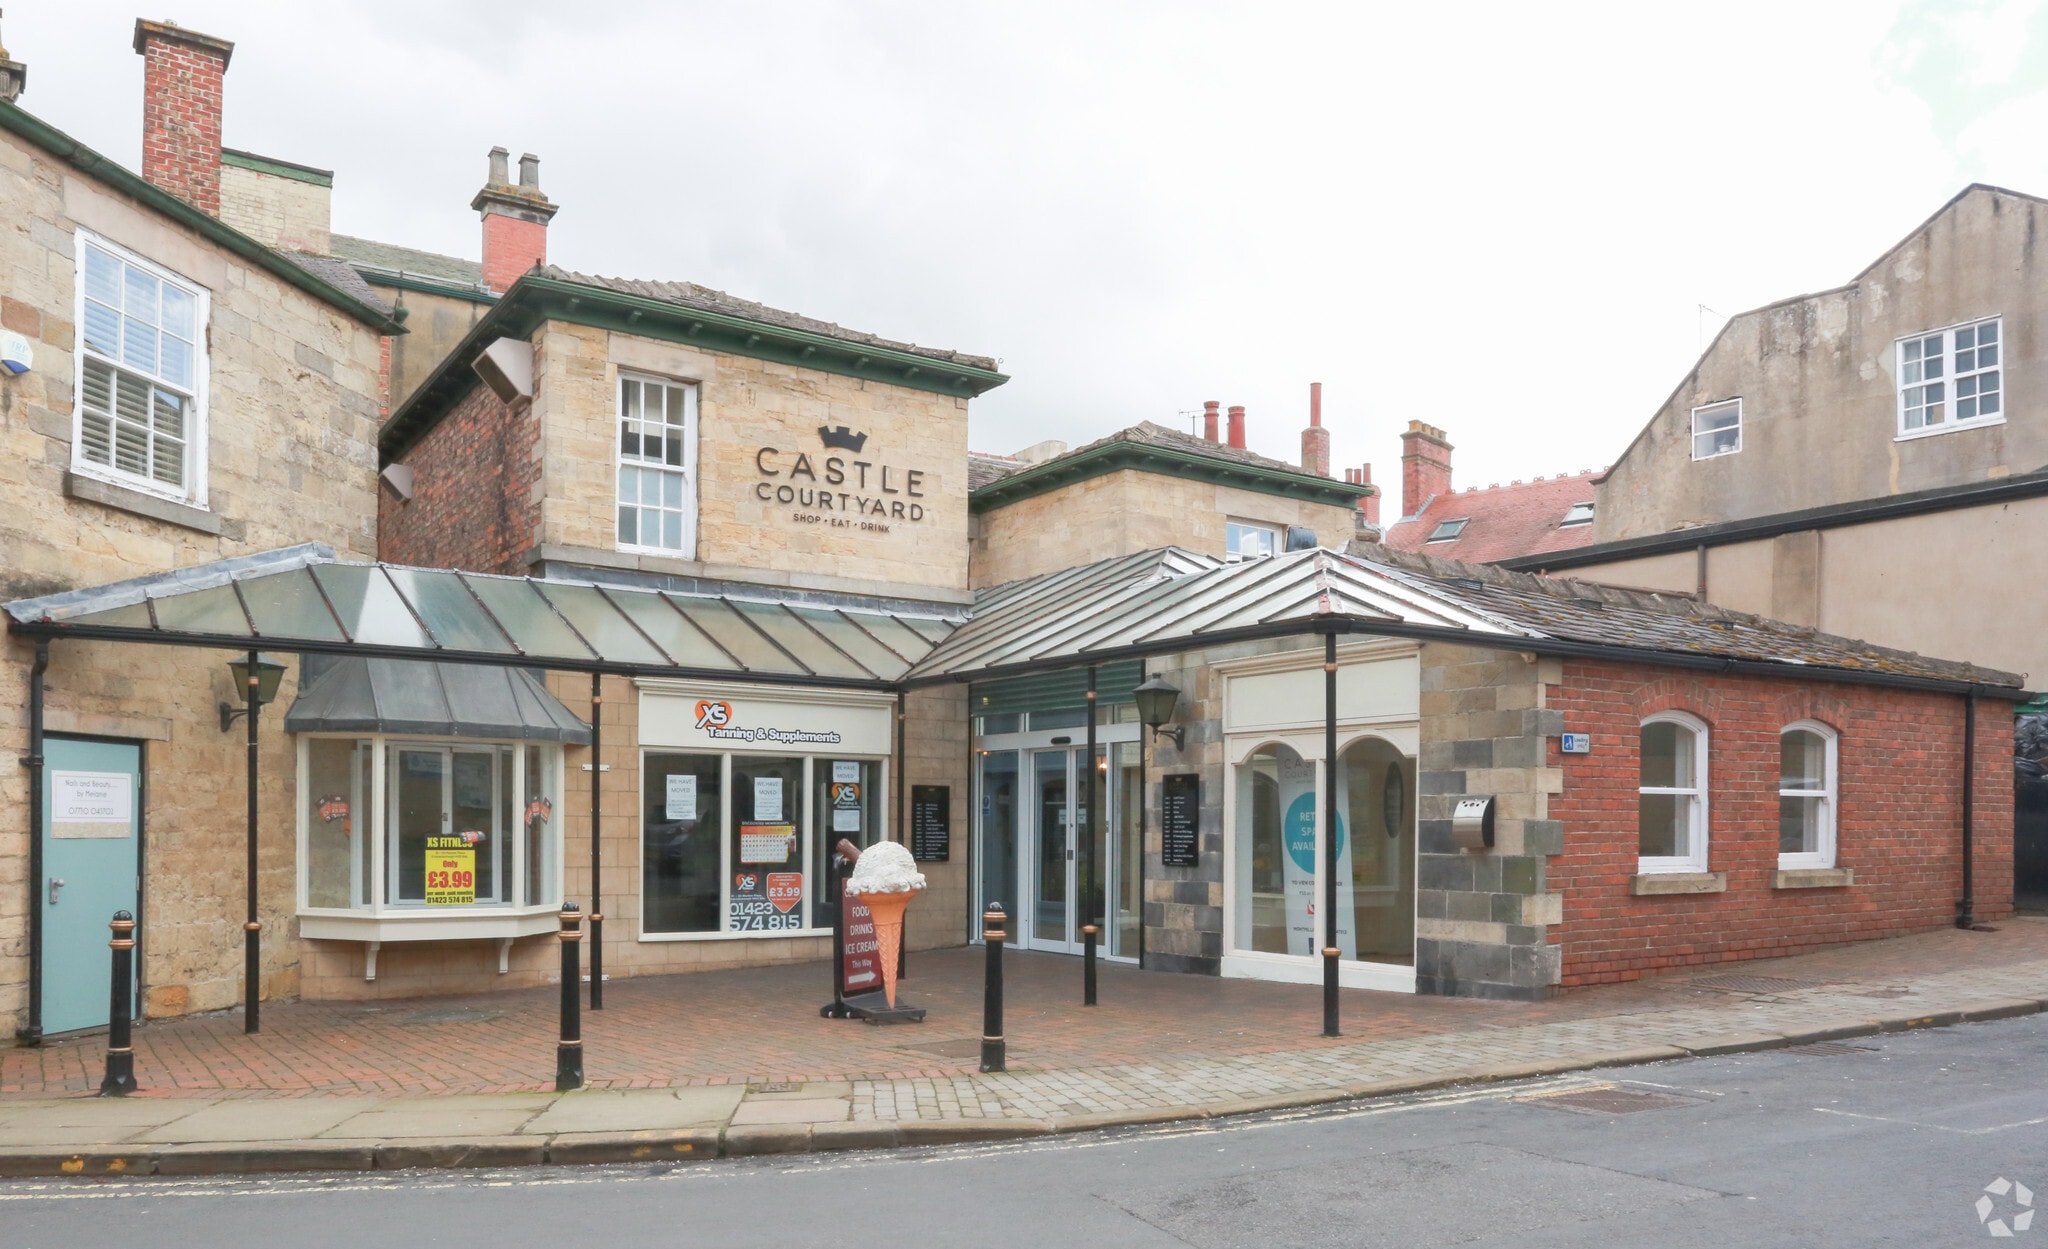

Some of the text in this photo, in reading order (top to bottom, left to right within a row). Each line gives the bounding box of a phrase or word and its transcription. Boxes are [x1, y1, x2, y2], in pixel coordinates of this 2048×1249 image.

[756, 446, 924, 497] CASTLE
[756, 482, 924, 521] COURTYARD
[793, 513, 890, 533] SHOP EAT DRINK
[695, 702, 728, 729] XS
[707, 726, 841, 744] Tanning & Supplements
[77, 790, 84, 798] by
[833, 786, 856, 805] XS
[427, 837, 439, 848] XS
[442, 860, 458, 868] Only
[428, 870, 473, 888] £3.99
[769, 887, 800, 897] £3.99
[427, 896, 473, 904] 01423 574 815
[730, 902, 774, 916] 01423
[852, 905, 870, 918] FOOD
[730, 914, 800, 931] 574 815
[850, 923, 874, 936] DRINKS
[845, 940, 879, 955] ICE CREAM
[852, 959, 873, 969] This Way
